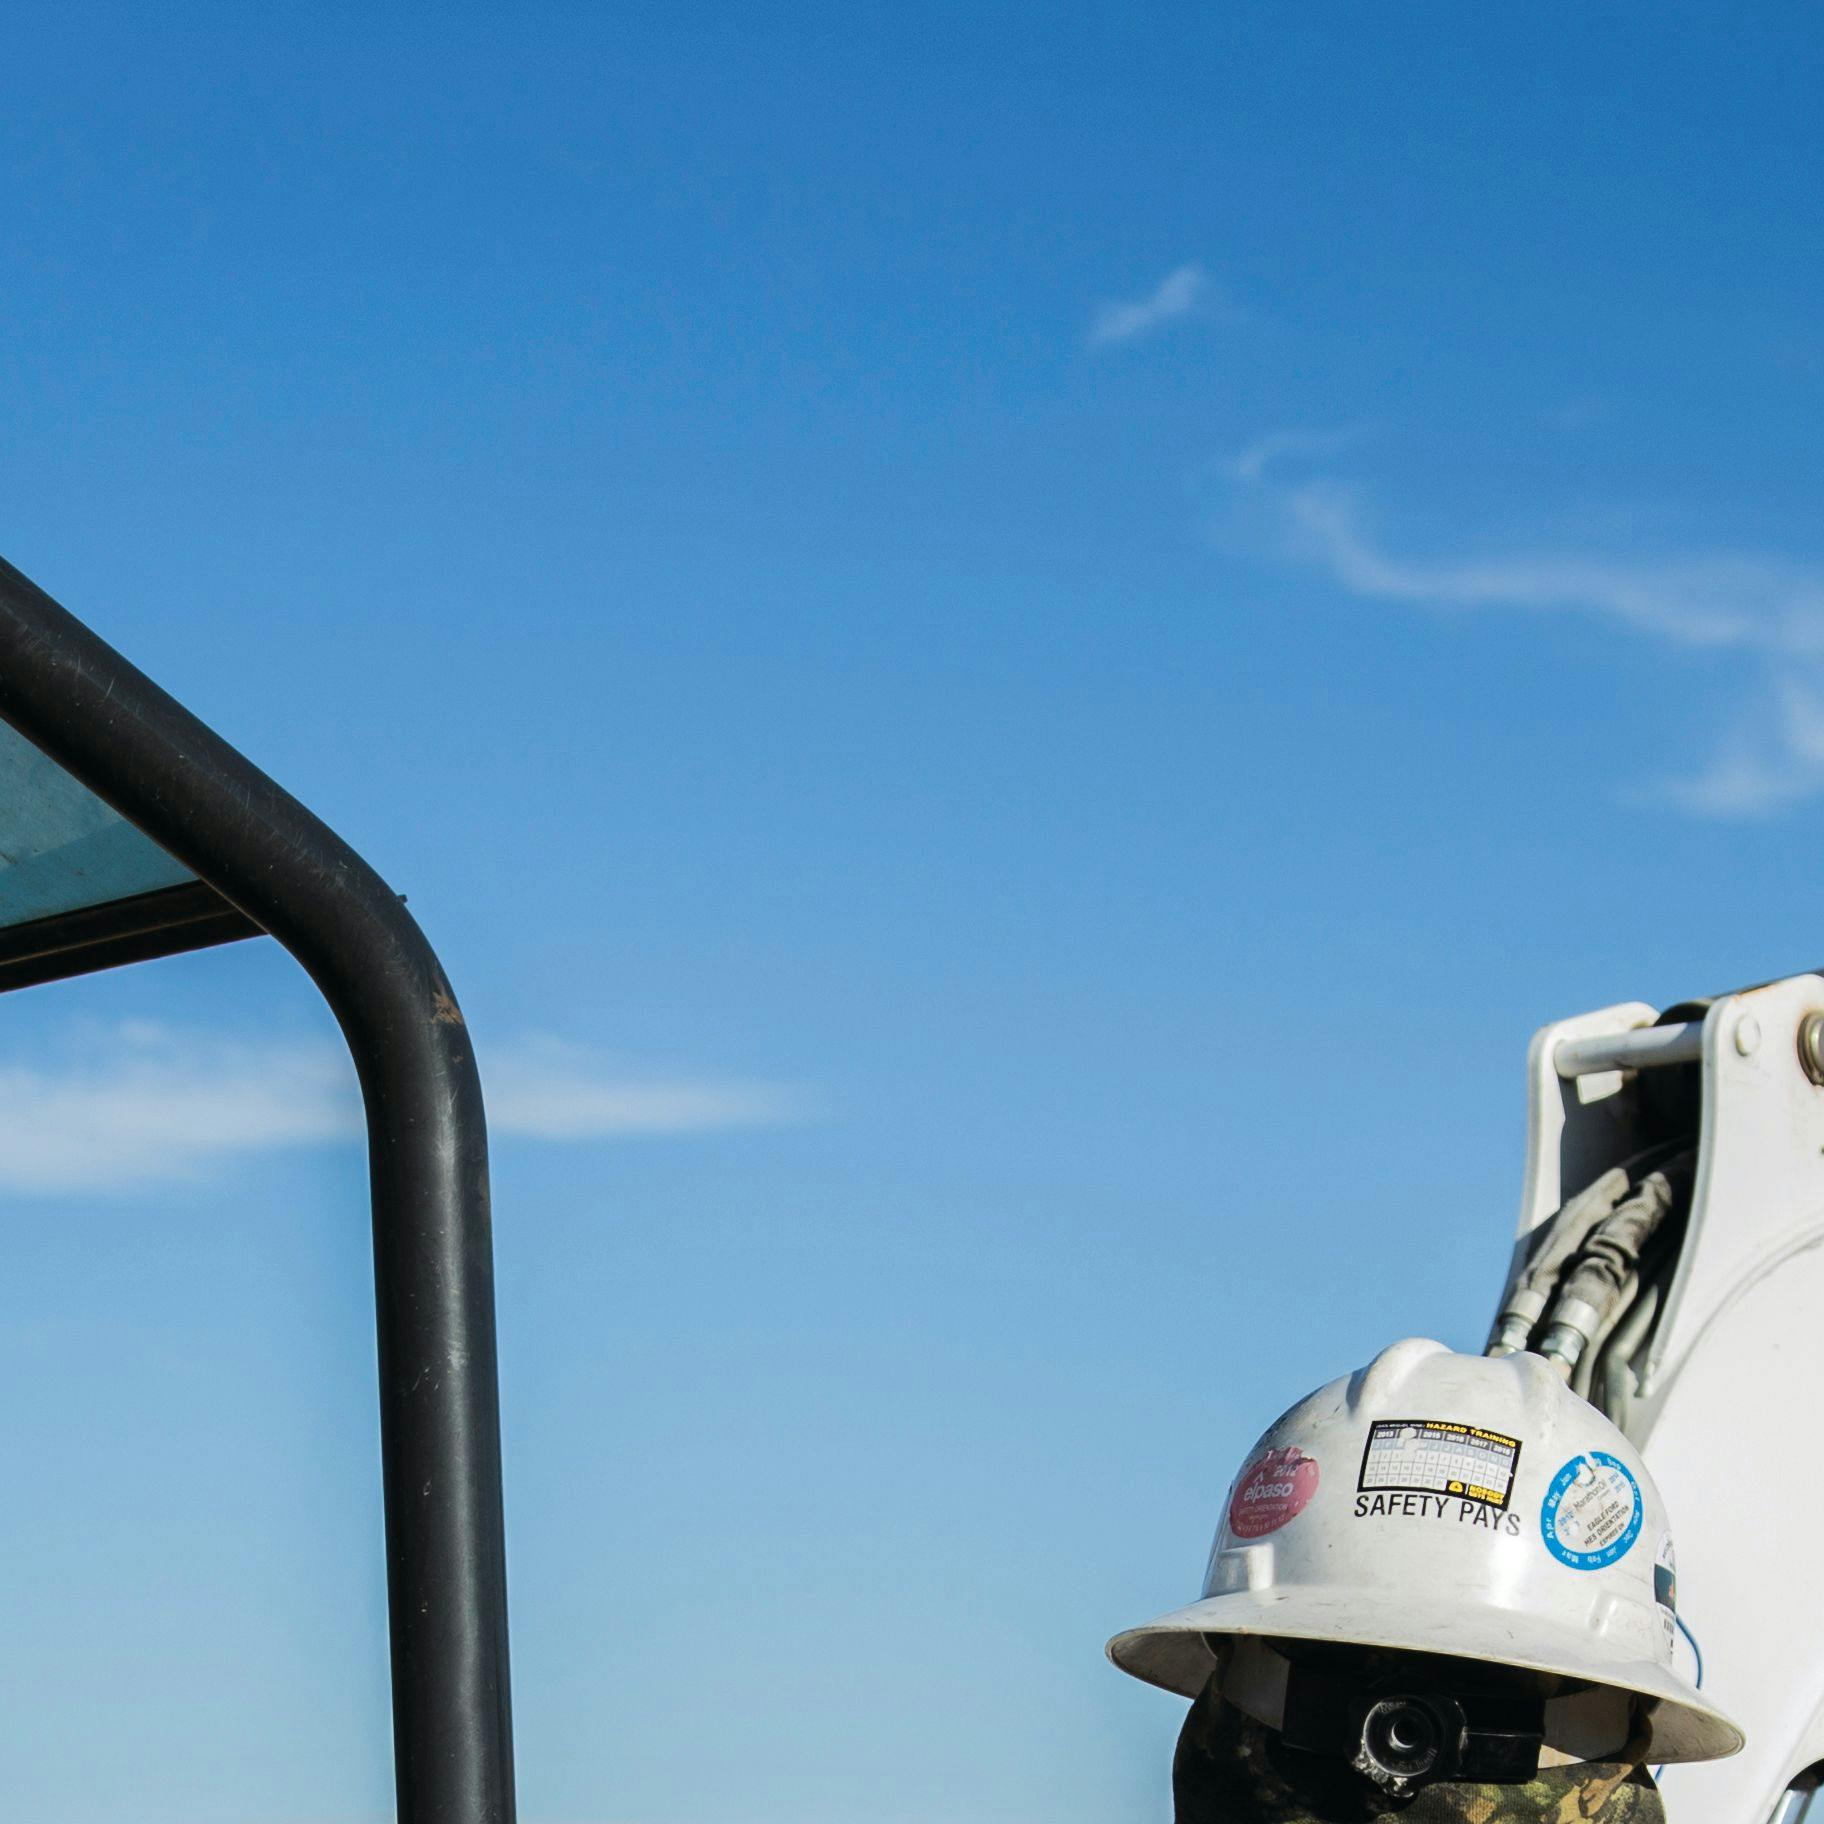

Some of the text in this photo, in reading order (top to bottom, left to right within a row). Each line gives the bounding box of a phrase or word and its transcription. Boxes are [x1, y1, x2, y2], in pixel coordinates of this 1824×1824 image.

[1426, 1423, 1516, 1448] HAZARD TRAINING
[1354, 1493, 1522, 1537] SAFETY PAYS
